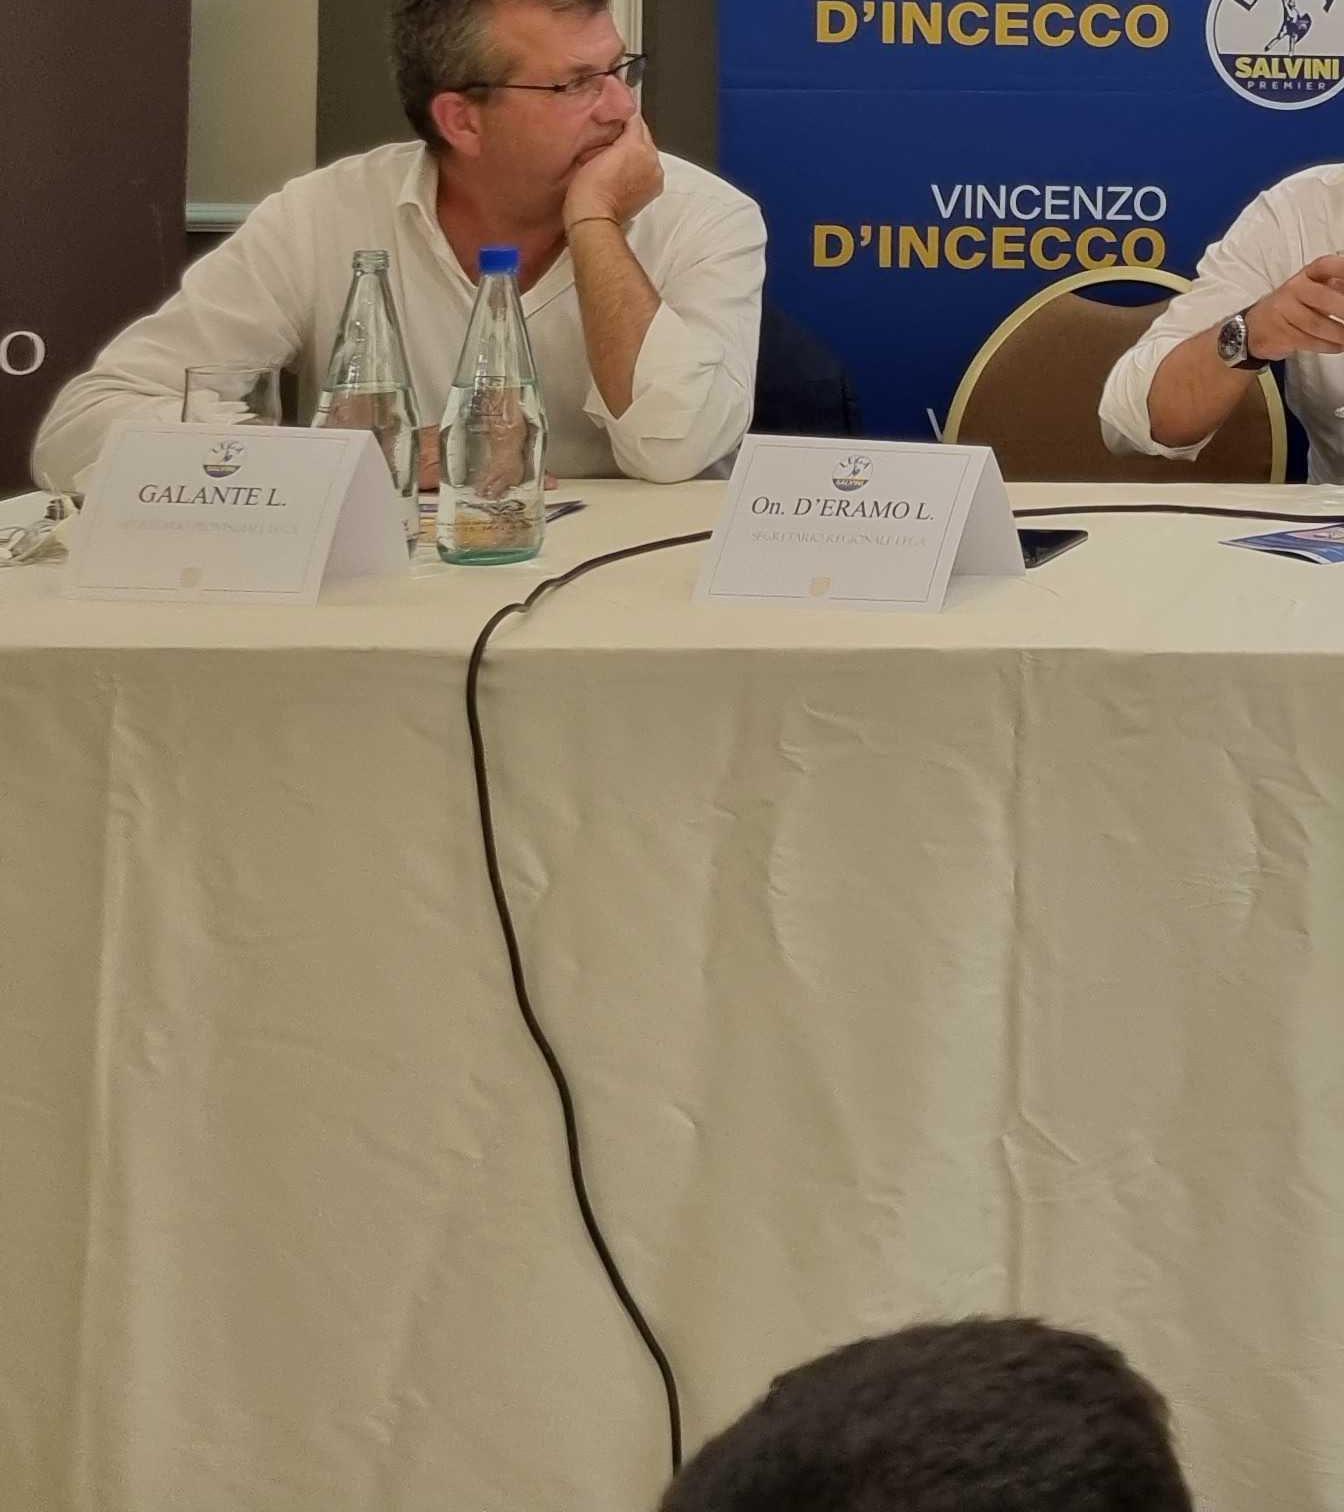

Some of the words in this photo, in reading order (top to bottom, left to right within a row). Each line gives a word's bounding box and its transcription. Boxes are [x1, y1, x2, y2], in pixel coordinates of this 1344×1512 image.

[816, 1, 1169, 47] D'INCECCO
[1235, 57, 1340, 80] SALVINI
[1247, 80, 1326, 90] PREMIER
[930, 184, 1167, 222] VINCENZO
[813, 224, 1166, 271] D'INCECCO
[138, 484, 261, 507] GALANTE
[266, 488, 287, 507] L.
[751, 496, 785, 516] On.
[792, 497, 910, 520] D'ERAMO
[915, 502, 935, 521] L.
